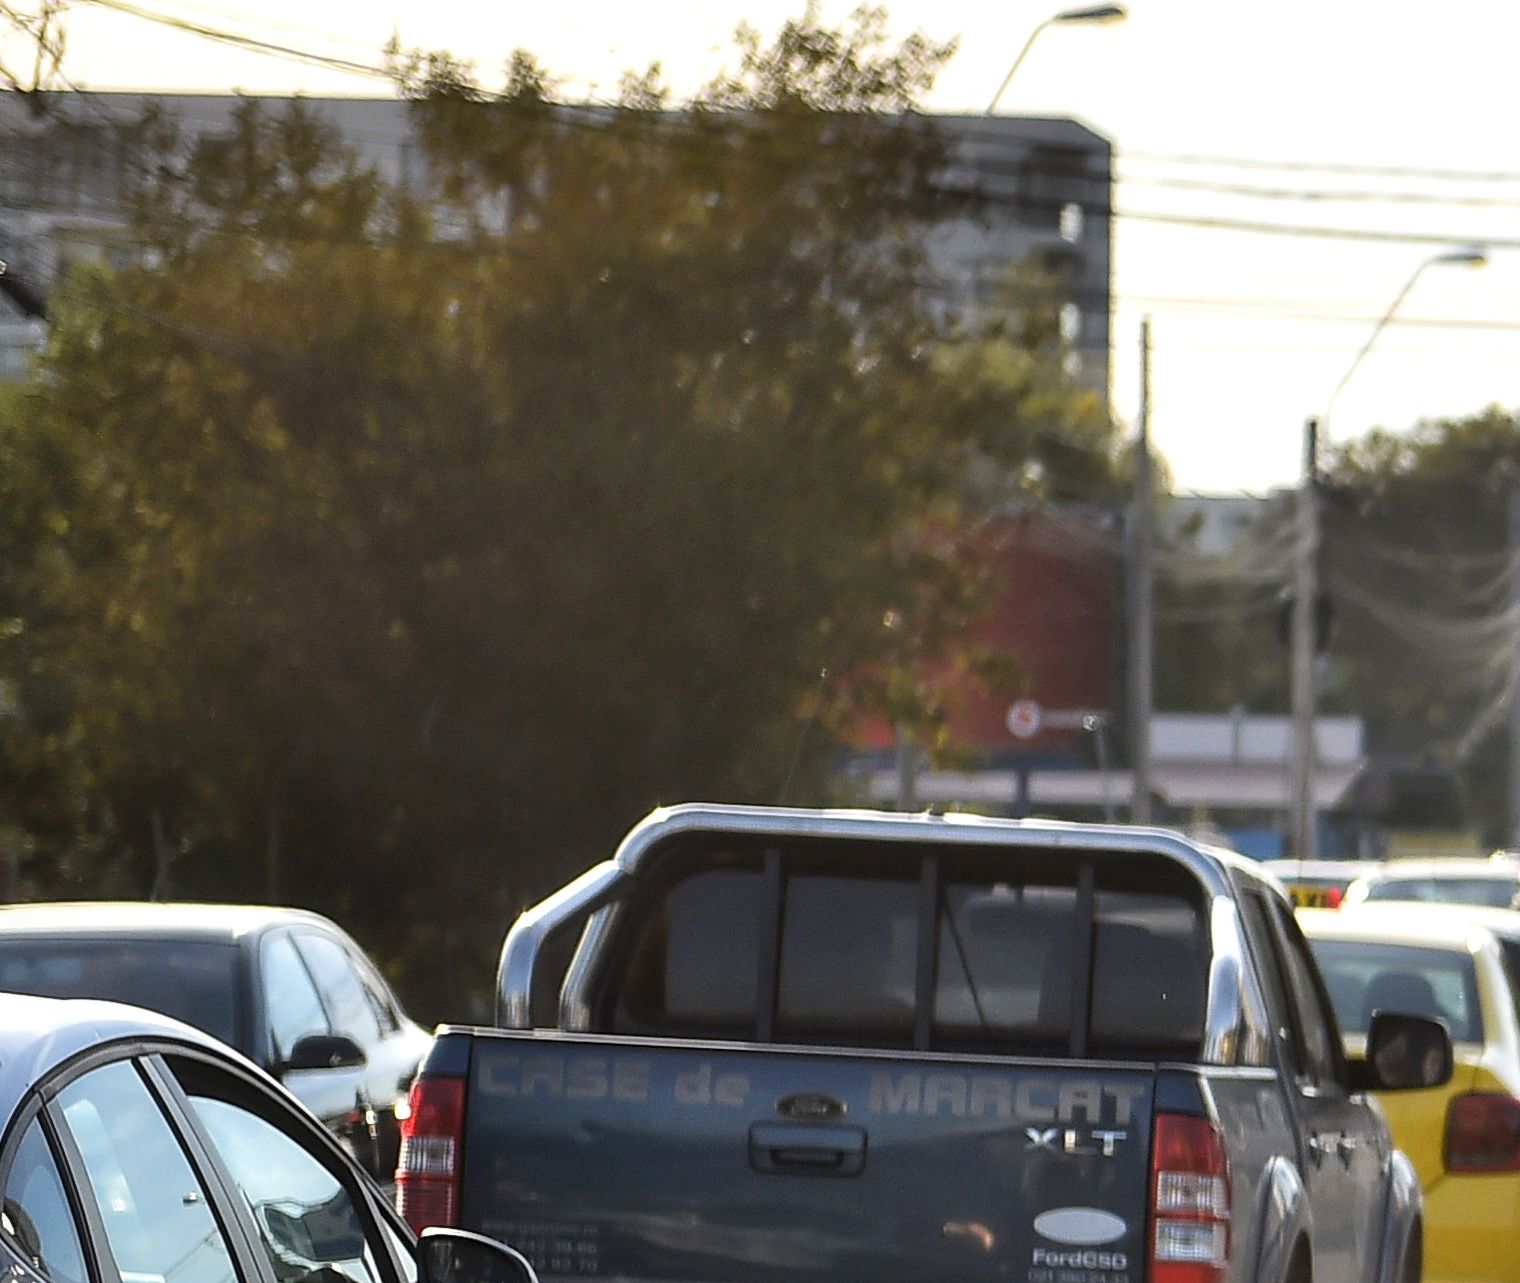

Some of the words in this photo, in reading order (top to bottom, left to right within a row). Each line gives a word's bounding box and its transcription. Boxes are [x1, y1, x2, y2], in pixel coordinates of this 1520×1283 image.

[478, 1054, 649, 1101] CASE
[674, 1065, 751, 1106] de
[869, 1073, 1145, 1123] MARCAT
[1025, 1127, 1127, 1156] XLT
